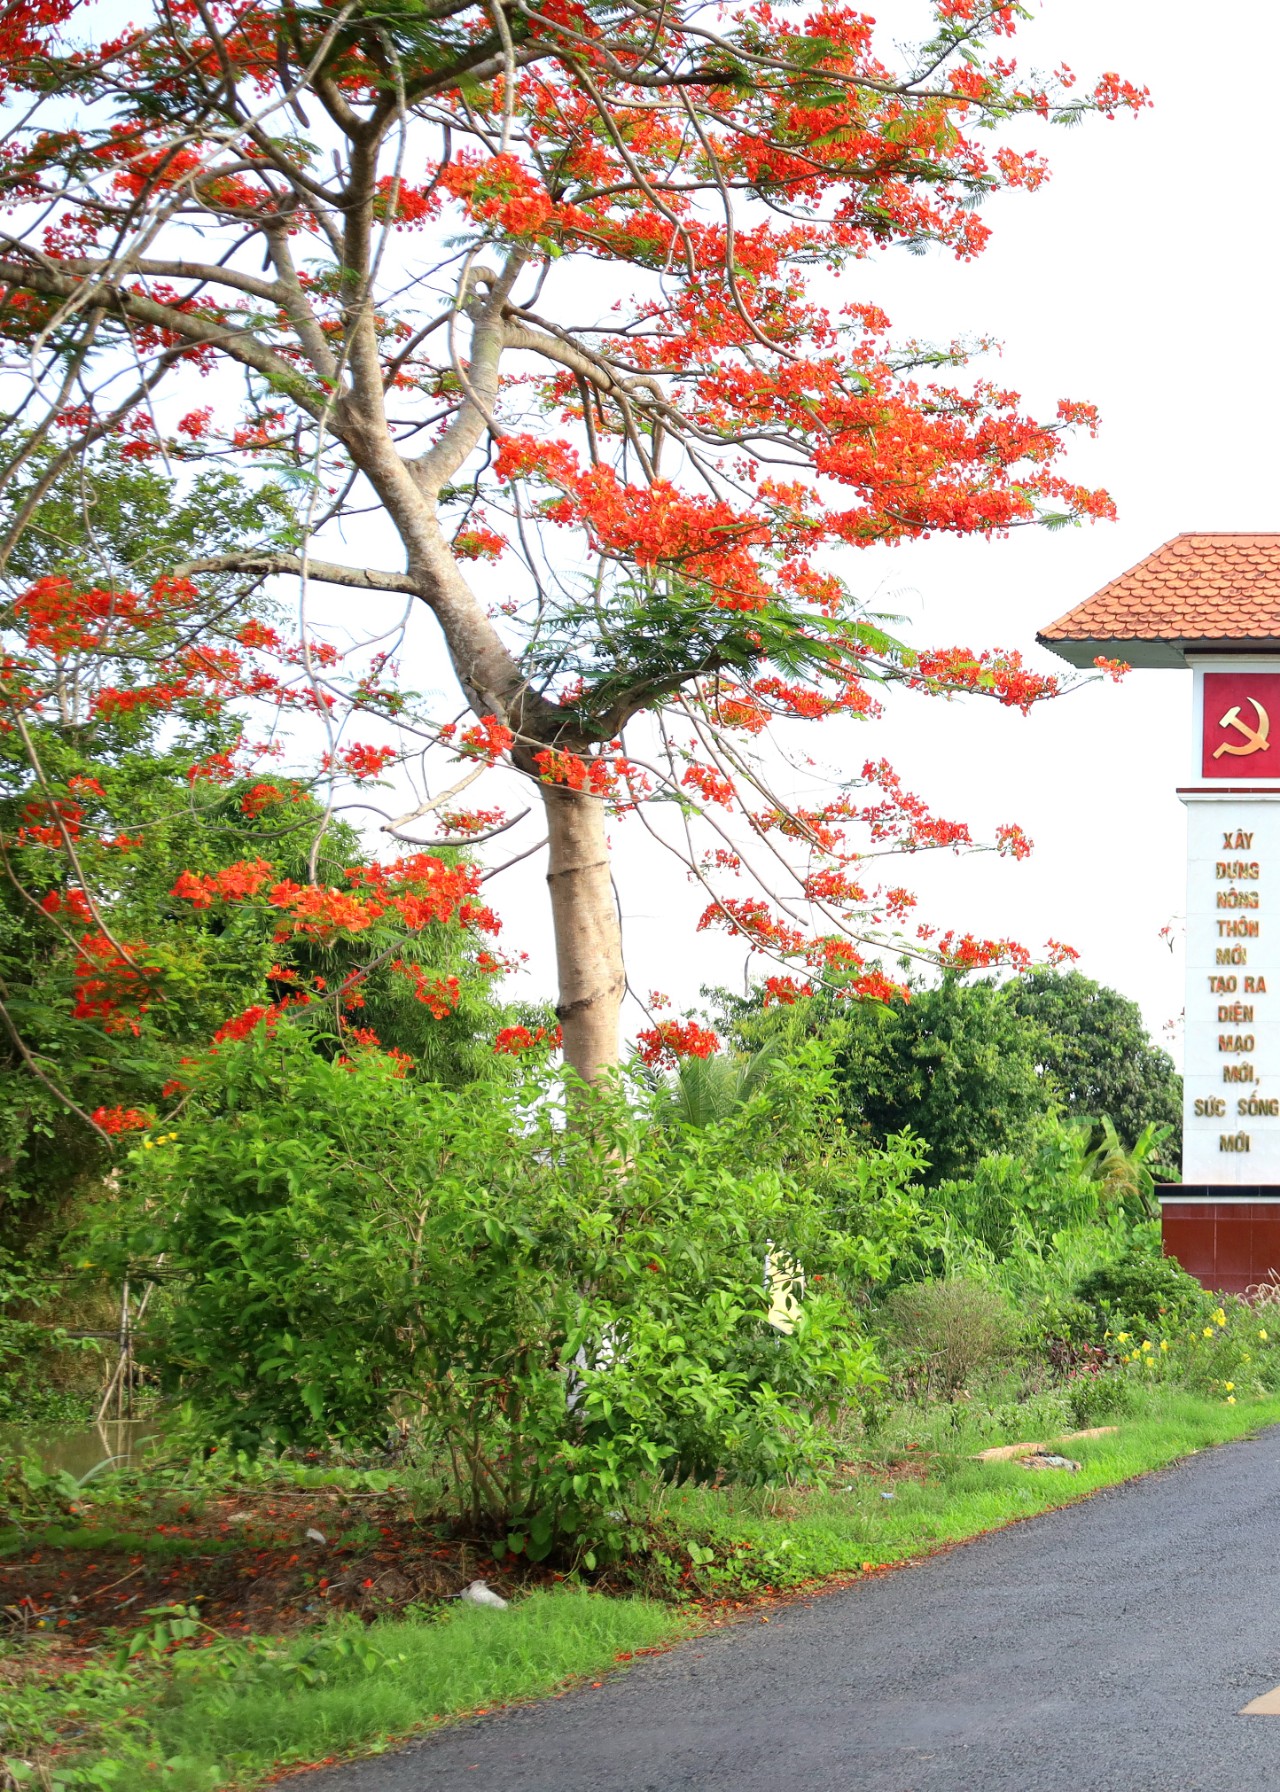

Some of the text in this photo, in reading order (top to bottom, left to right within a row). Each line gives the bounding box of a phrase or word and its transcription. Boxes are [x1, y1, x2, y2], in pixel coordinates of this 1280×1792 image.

[1222, 828, 1254, 850] XÂY
[1215, 860, 1260, 883] DỰNG
[1215, 887, 1260, 909] NÔNG
[1216, 915, 1259, 938] THÔN
[1215, 942, 1247, 966] MỚI
[1207, 974, 1266, 996] TẠO RA
[1217, 1000, 1254, 1026] DIỆN
[1218, 1034, 1255, 1056] MẠO
[1194, 1089, 1280, 1117] SỨC SỐNG
[1219, 1130, 1250, 1153] MỚI
